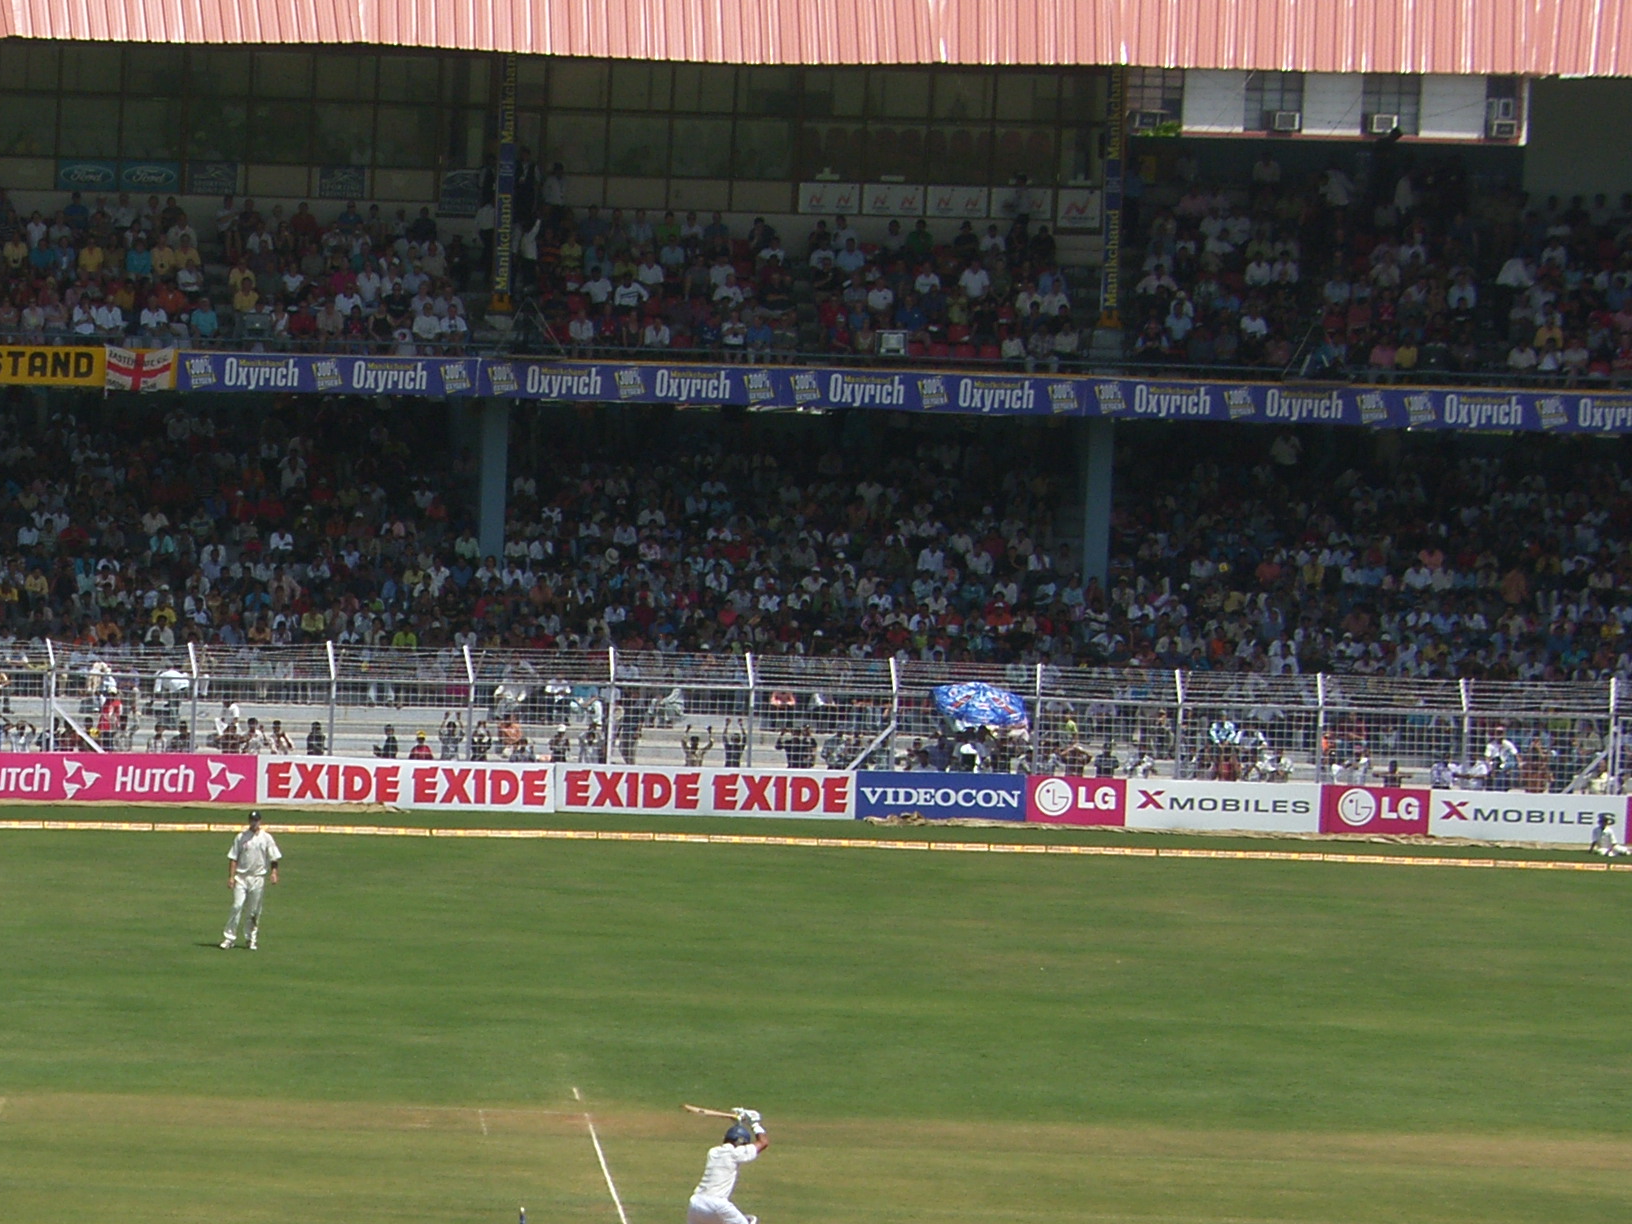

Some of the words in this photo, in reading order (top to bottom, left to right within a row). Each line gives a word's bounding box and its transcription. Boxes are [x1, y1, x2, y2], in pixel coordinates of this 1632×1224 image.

[224, 357, 299, 389] Oxyrich
[352, 360, 427, 391] Oxyrich
[526, 365, 601, 397] Oxyrich
[655, 369, 730, 400] Oxyrich
[828, 373, 904, 406] Oxyrich
[958, 378, 1034, 411] Oxyrich
[1134, 384, 1210, 417] Oxyrich
[1265, 388, 1343, 420] Oxyrich
[1444, 394, 1522, 428] Oxyrich
[265, 762, 400, 804] EXIDE
[412, 766, 547, 805] EXIDE
[564, 770, 700, 810] EXIDE
[712, 773, 849, 813] EXIDE
[860, 787, 1021, 809] VIDEOCON
[1077, 787, 1117, 810] LG
[1380, 797, 1421, 819] LG
